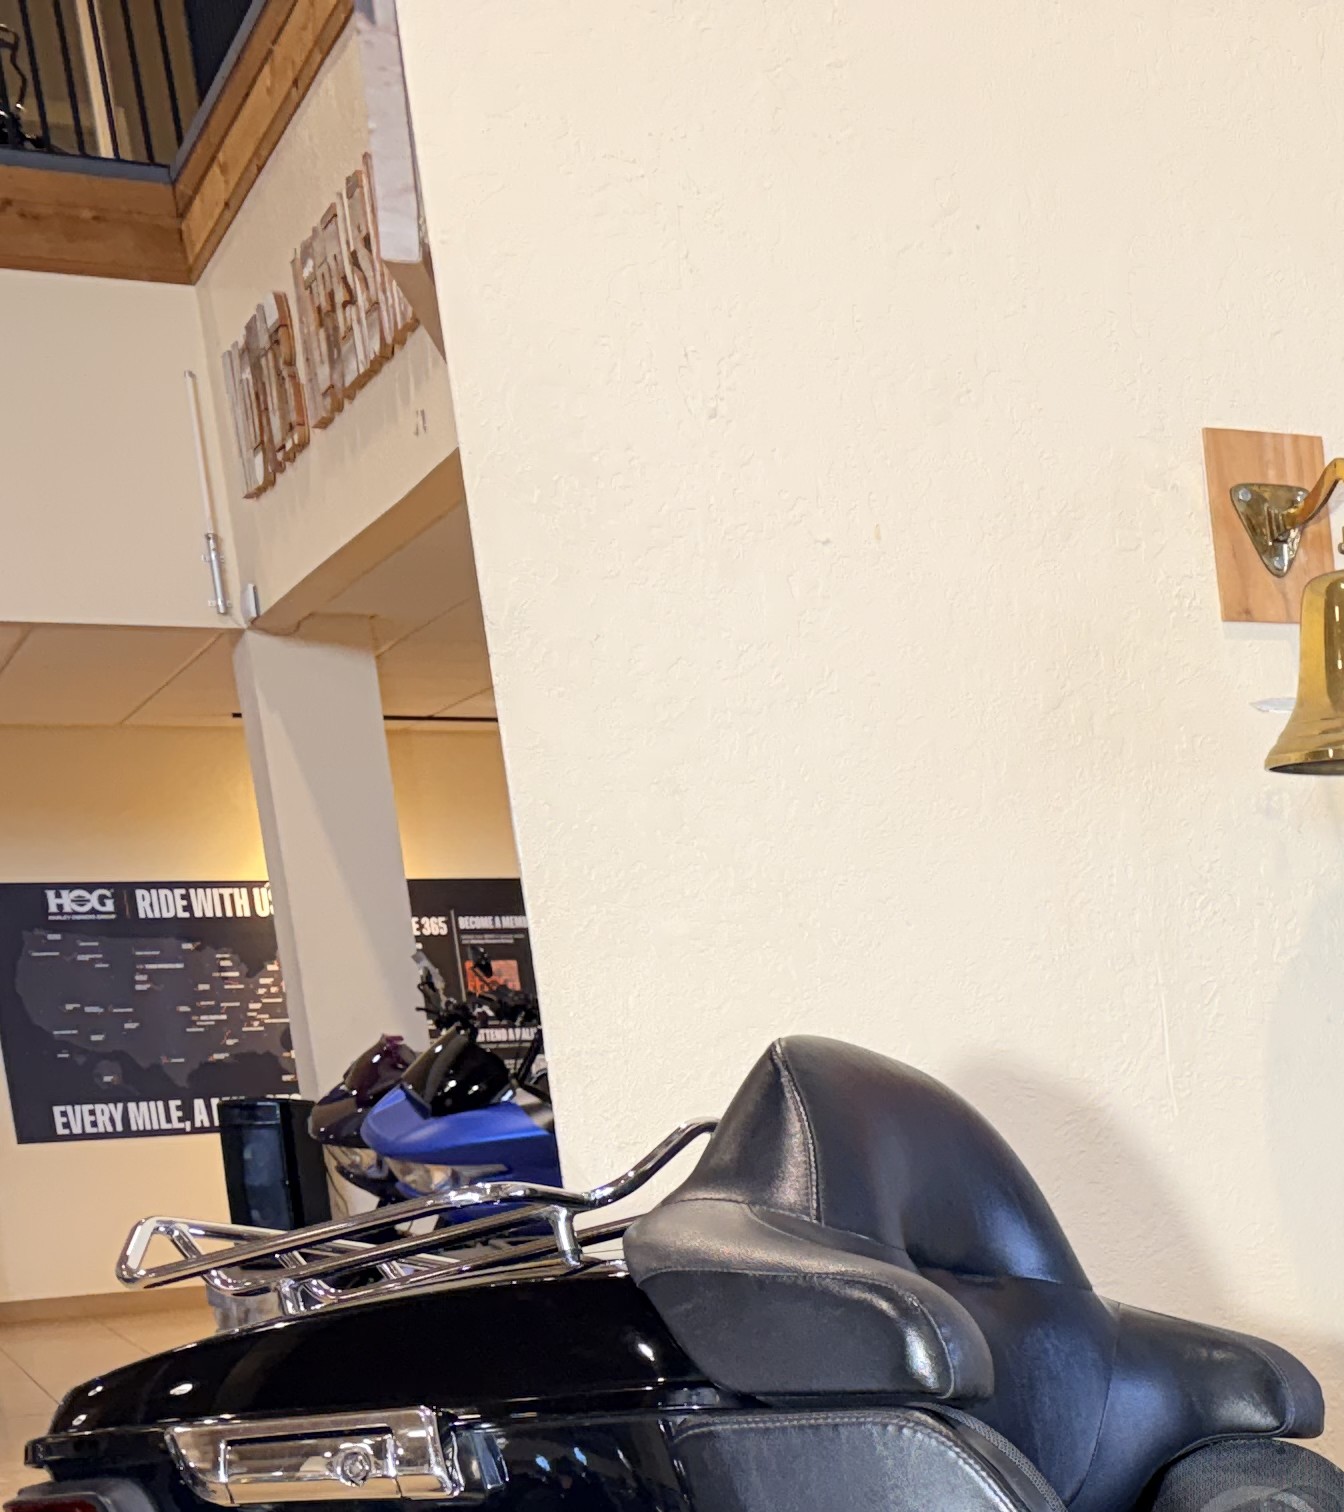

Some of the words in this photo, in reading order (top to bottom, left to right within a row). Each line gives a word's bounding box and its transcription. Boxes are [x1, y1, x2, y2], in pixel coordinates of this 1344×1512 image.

[44, 888, 115, 913] HOG
[135, 888, 191, 919] RIDE
[190, 887, 251, 918] WITH
[421, 916, 448, 936] 365
[52, 1101, 124, 1136] EVERY
[127, 1099, 192, 1133] MILE,
[193, 1098, 211, 1129] A
